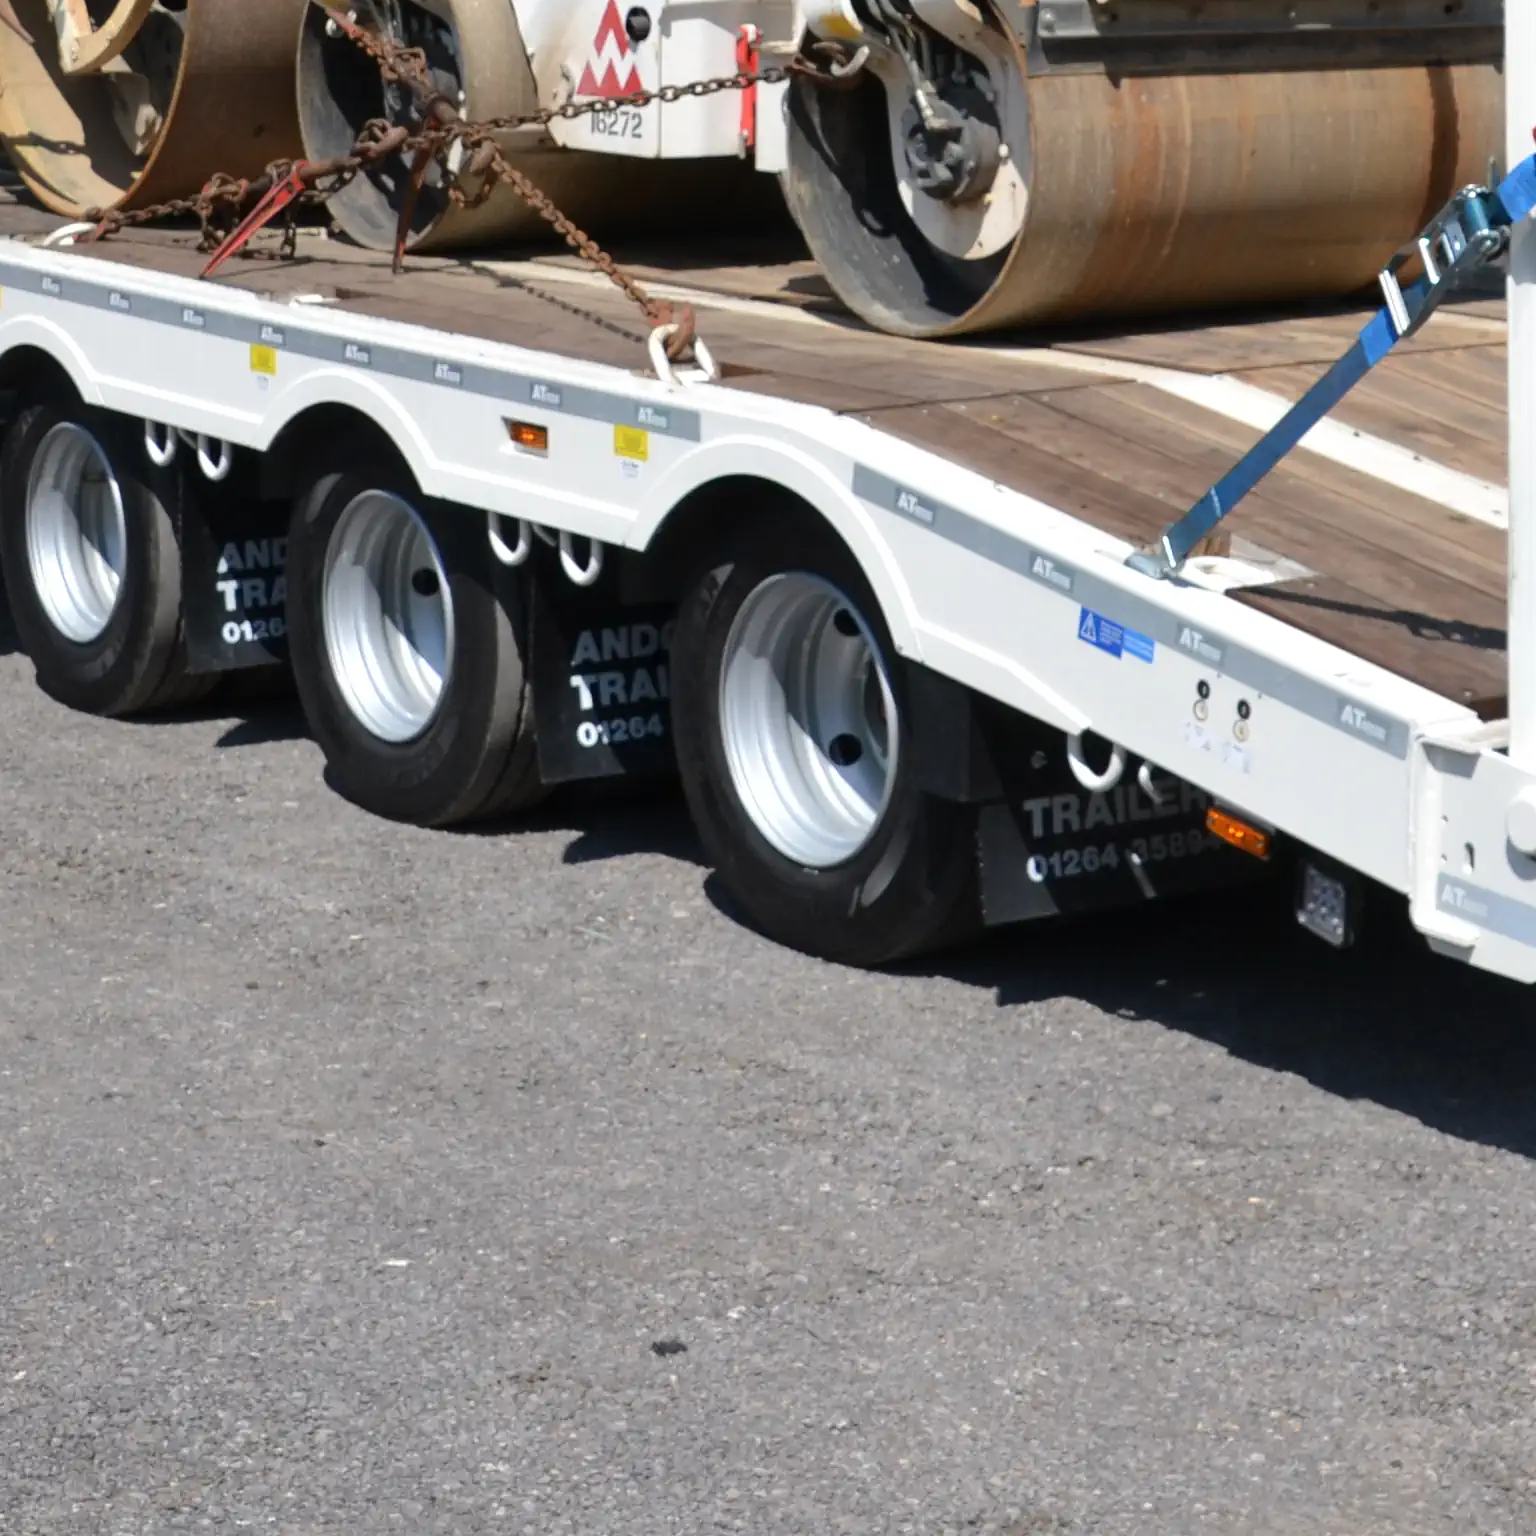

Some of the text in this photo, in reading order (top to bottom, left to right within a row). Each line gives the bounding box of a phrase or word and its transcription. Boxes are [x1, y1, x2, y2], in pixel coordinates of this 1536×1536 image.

[590, 110, 643, 138] 16272
[1023, 775, 1210, 840] TRAILER
[1027, 842, 1118, 883] 01264
